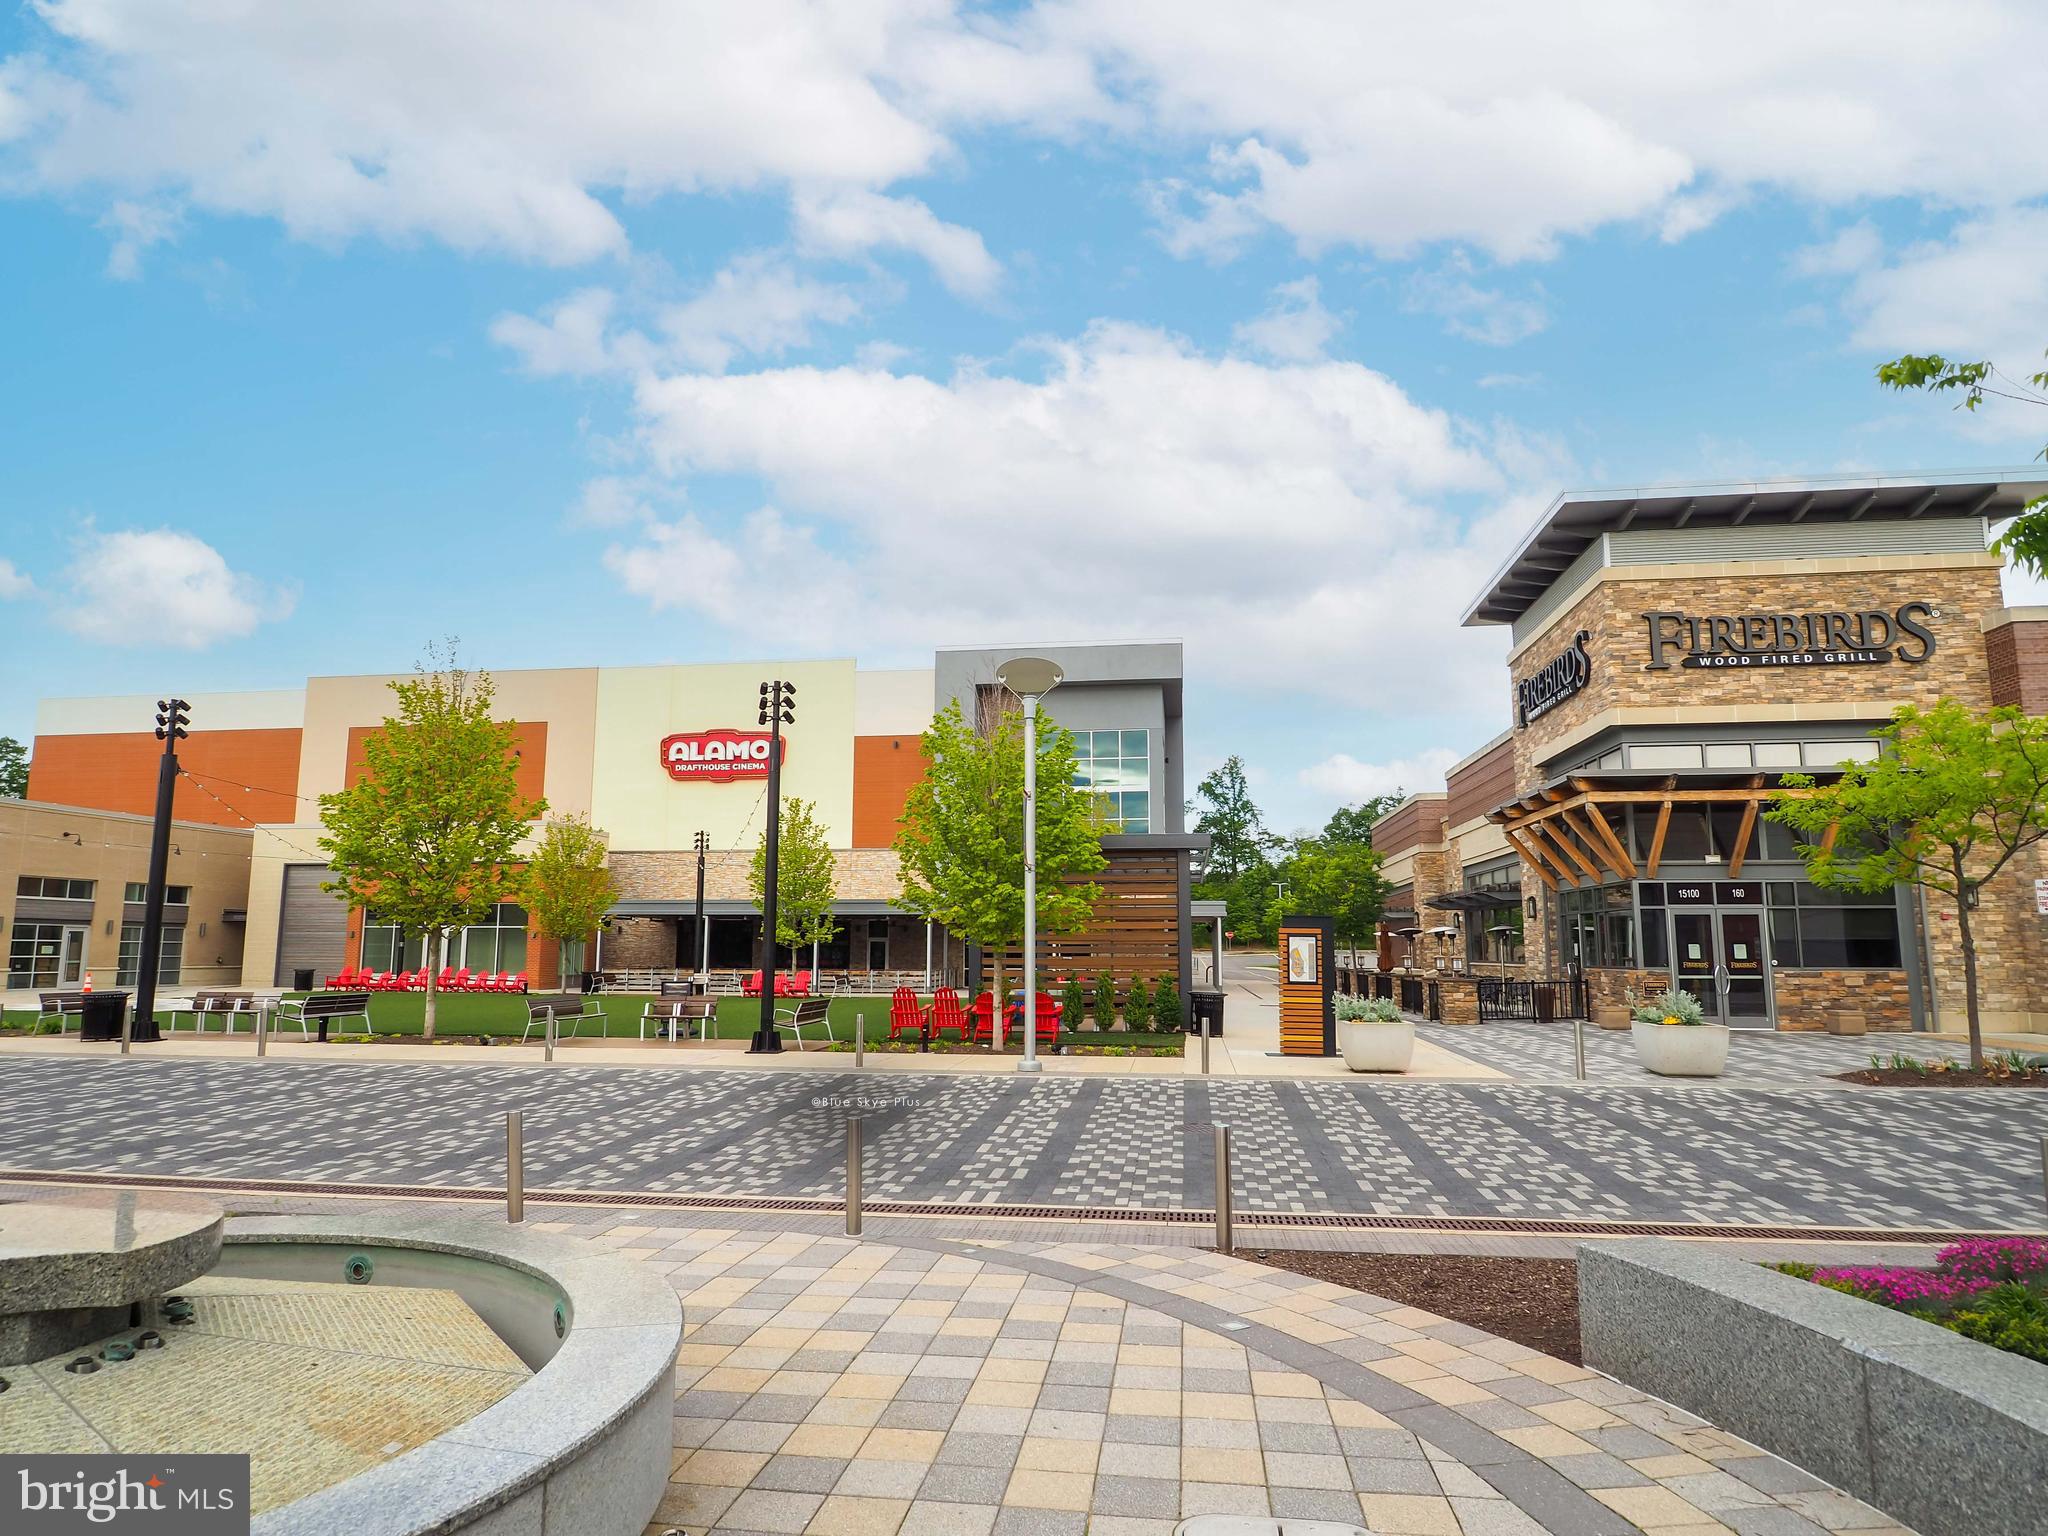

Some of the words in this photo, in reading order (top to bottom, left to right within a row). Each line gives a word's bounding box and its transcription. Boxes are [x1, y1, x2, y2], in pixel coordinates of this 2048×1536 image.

[1642, 601, 1936, 669] FIREBIRDS
[1699, 656, 1751, 667] WOOD
[1762, 654, 1813, 664] FIRED
[1824, 652, 1878, 662] GRILL
[1518, 630, 1592, 729] FIREBIRDS
[668, 739, 770, 761] ALAMO
[675, 763, 731, 771] DRAFTHOUSE
[732, 762, 766, 770] CINEMA
[1678, 889, 1700, 898] 15100
[1732, 888, 1745, 898] 160
